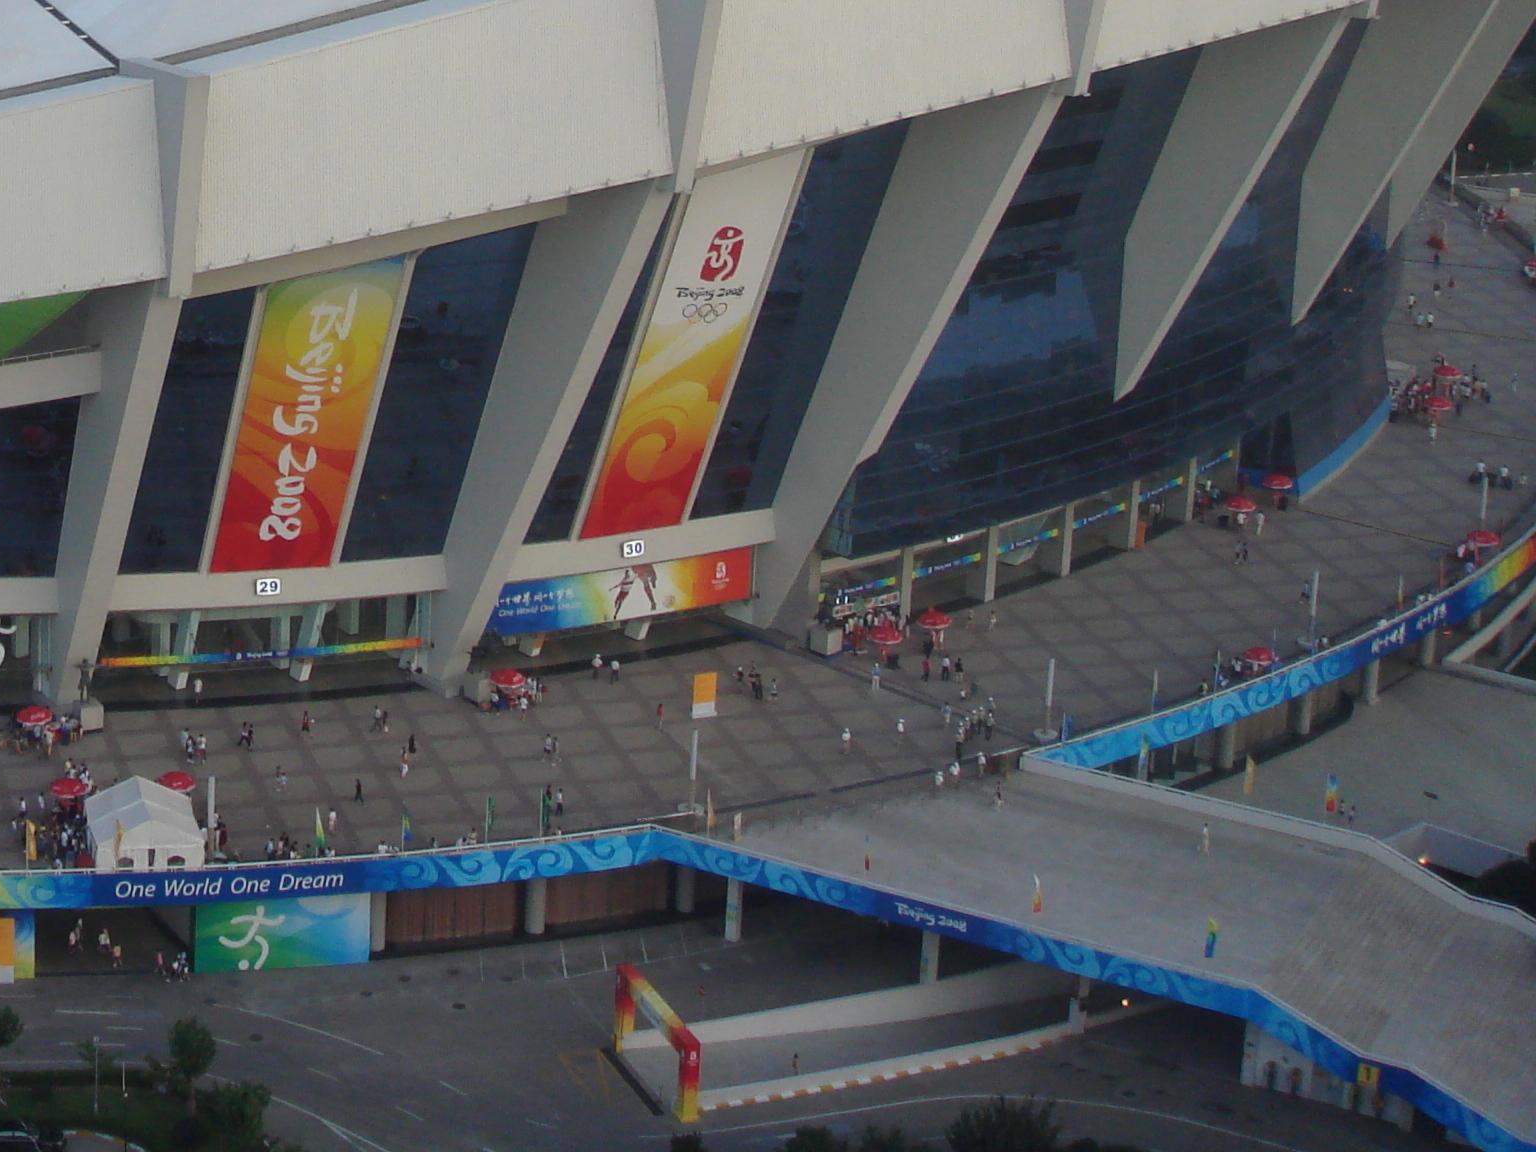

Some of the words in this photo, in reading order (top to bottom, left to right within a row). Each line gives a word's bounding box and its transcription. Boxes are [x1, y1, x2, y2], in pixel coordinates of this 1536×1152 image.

[675, 287, 714, 301] Beijing
[716, 286, 745, 297] 2008
[272, 287, 358, 436] Beijing
[259, 443, 317, 541] 2008
[626, 542, 642, 556] 30
[259, 580, 278, 593] 29
[115, 880, 156, 898] One
[164, 877, 222, 897] World
[230, 876, 271, 894] One
[279, 873, 344, 891] Dream
[894, 902, 936, 926] Beijing
[937, 915, 967, 932] 2008
